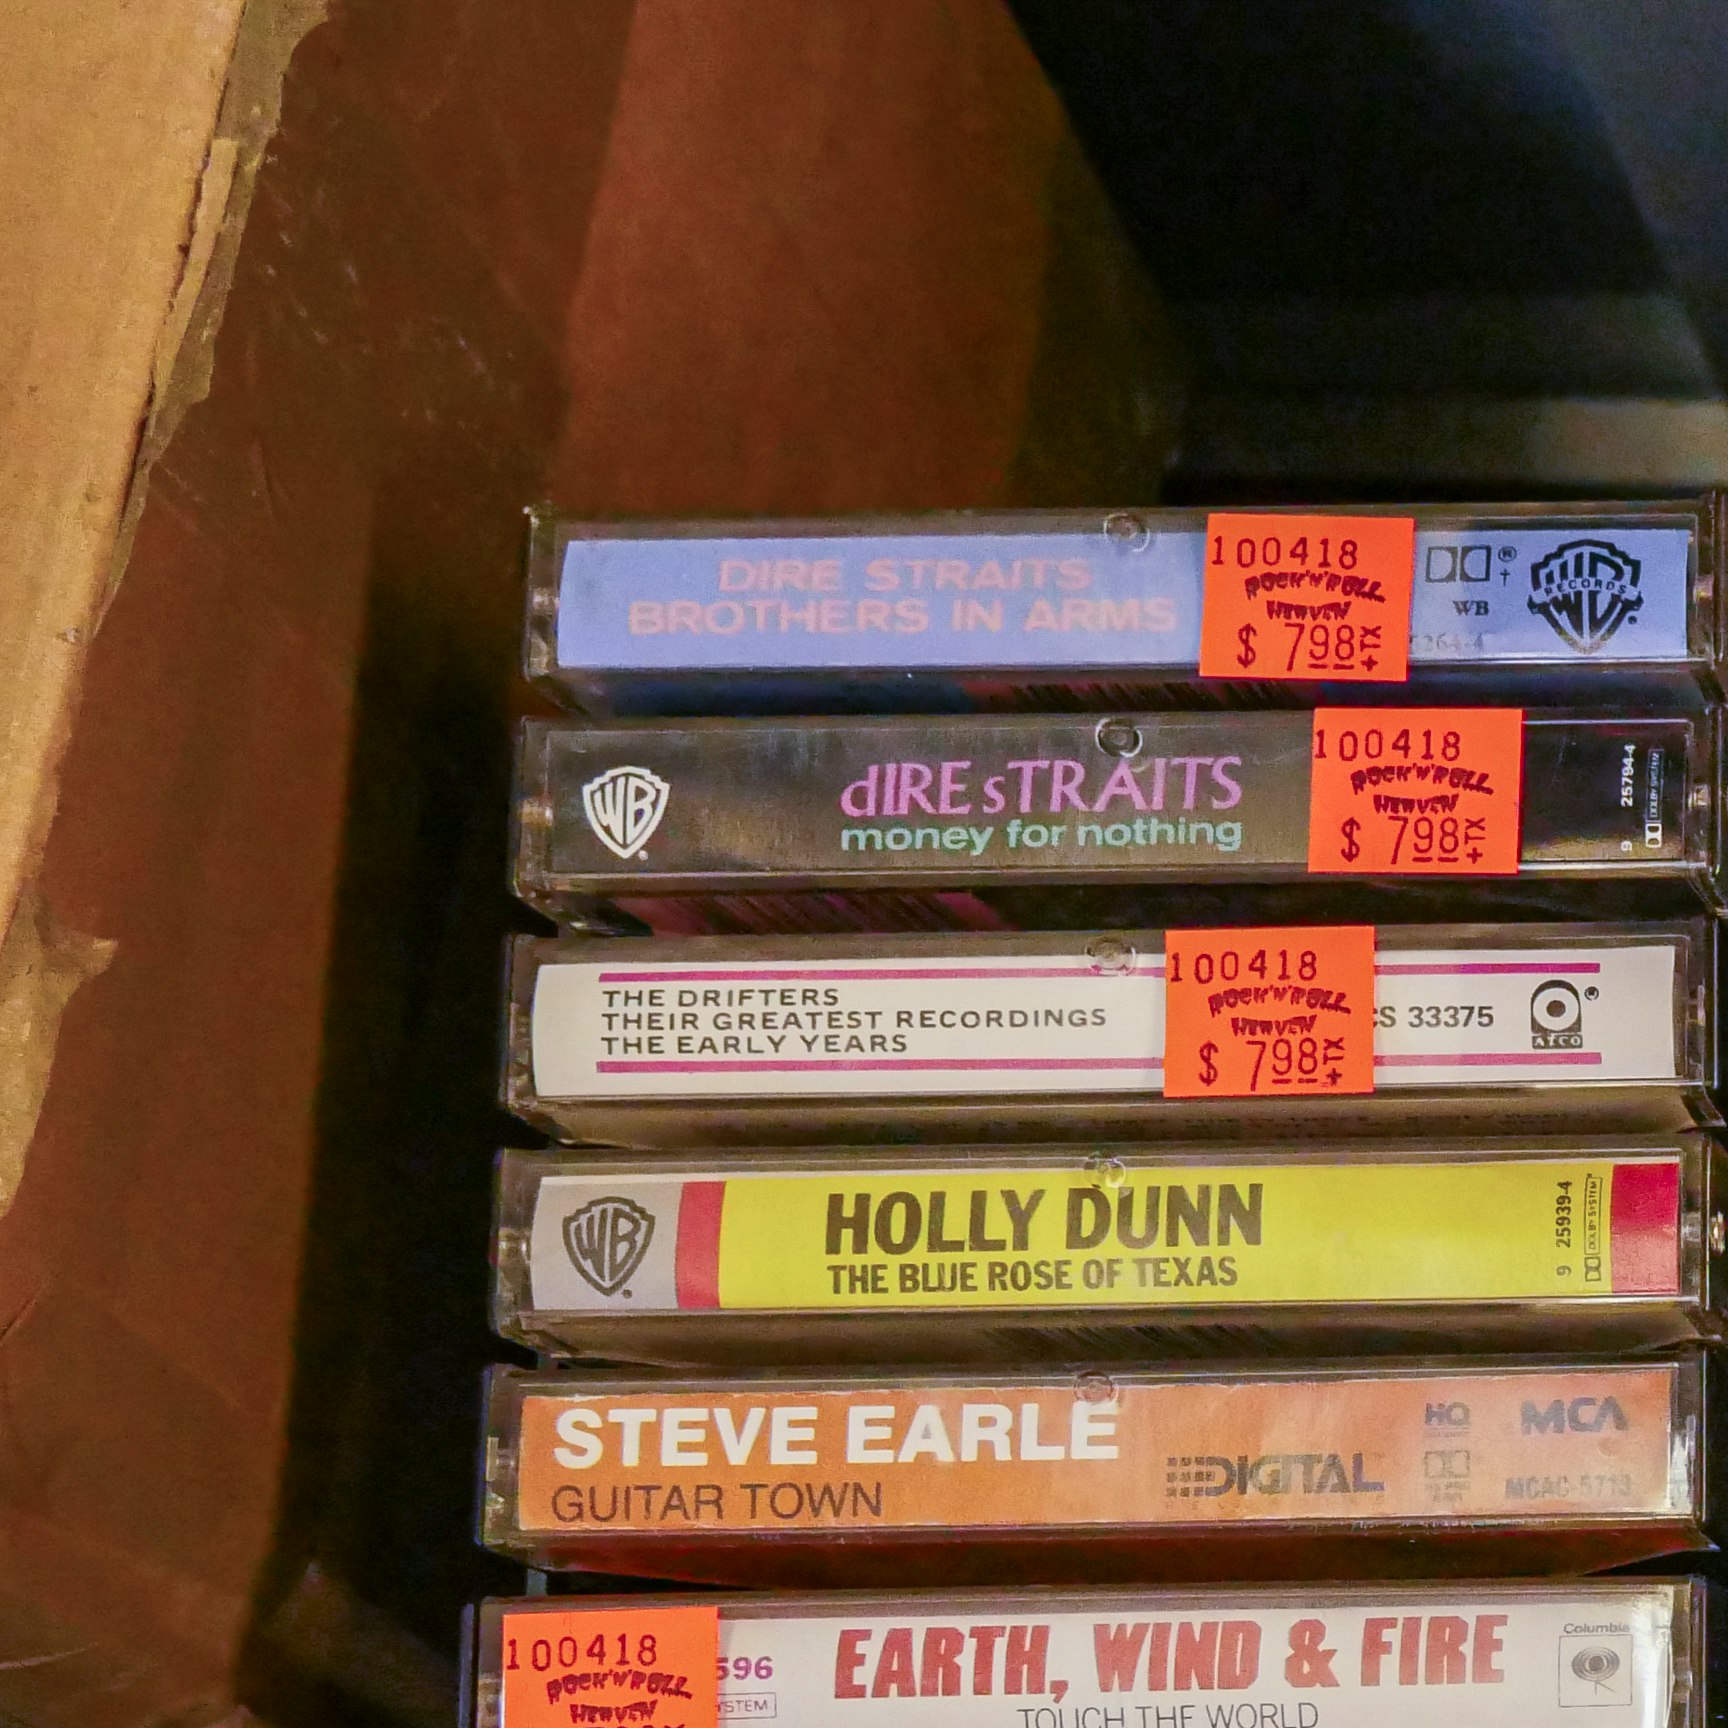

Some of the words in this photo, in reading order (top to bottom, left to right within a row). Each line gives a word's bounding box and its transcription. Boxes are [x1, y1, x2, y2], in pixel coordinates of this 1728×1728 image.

[720, 558, 842, 593] DIRE
[864, 556, 1091, 592] STRAITS
[629, 598, 928, 635] BROTHERS
[952, 599, 1001, 632] IN
[1024, 598, 1177, 633] ARMS
[841, 825, 993, 856] money
[1007, 820, 1066, 850] for
[1077, 819, 1242, 852] nothing
[602, 989, 665, 1008] THE
[678, 988, 839, 1007] DRIFTERS
[602, 1012, 699, 1031] THEIR
[712, 1010, 883, 1031] GREATEST
[896, 1008, 1106, 1028] RECORDINGS
[825, 1189, 1046, 1256] HOLLY
[1065, 1182, 1264, 1251] DUNN
[553, 1406, 819, 1469] STEVE
[845, 1401, 1119, 1464] EARLE
[551, 1484, 724, 1523] GUITAR
[740, 1482, 882, 1520] TOWN
[505, 1635, 658, 1672] 100418
[833, 1625, 1070, 1705] EARTH,
[1093, 1620, 1263, 1694] WIND
[1284, 1619, 1340, 1690] &
[1359, 1614, 1508, 1689] FIRE
